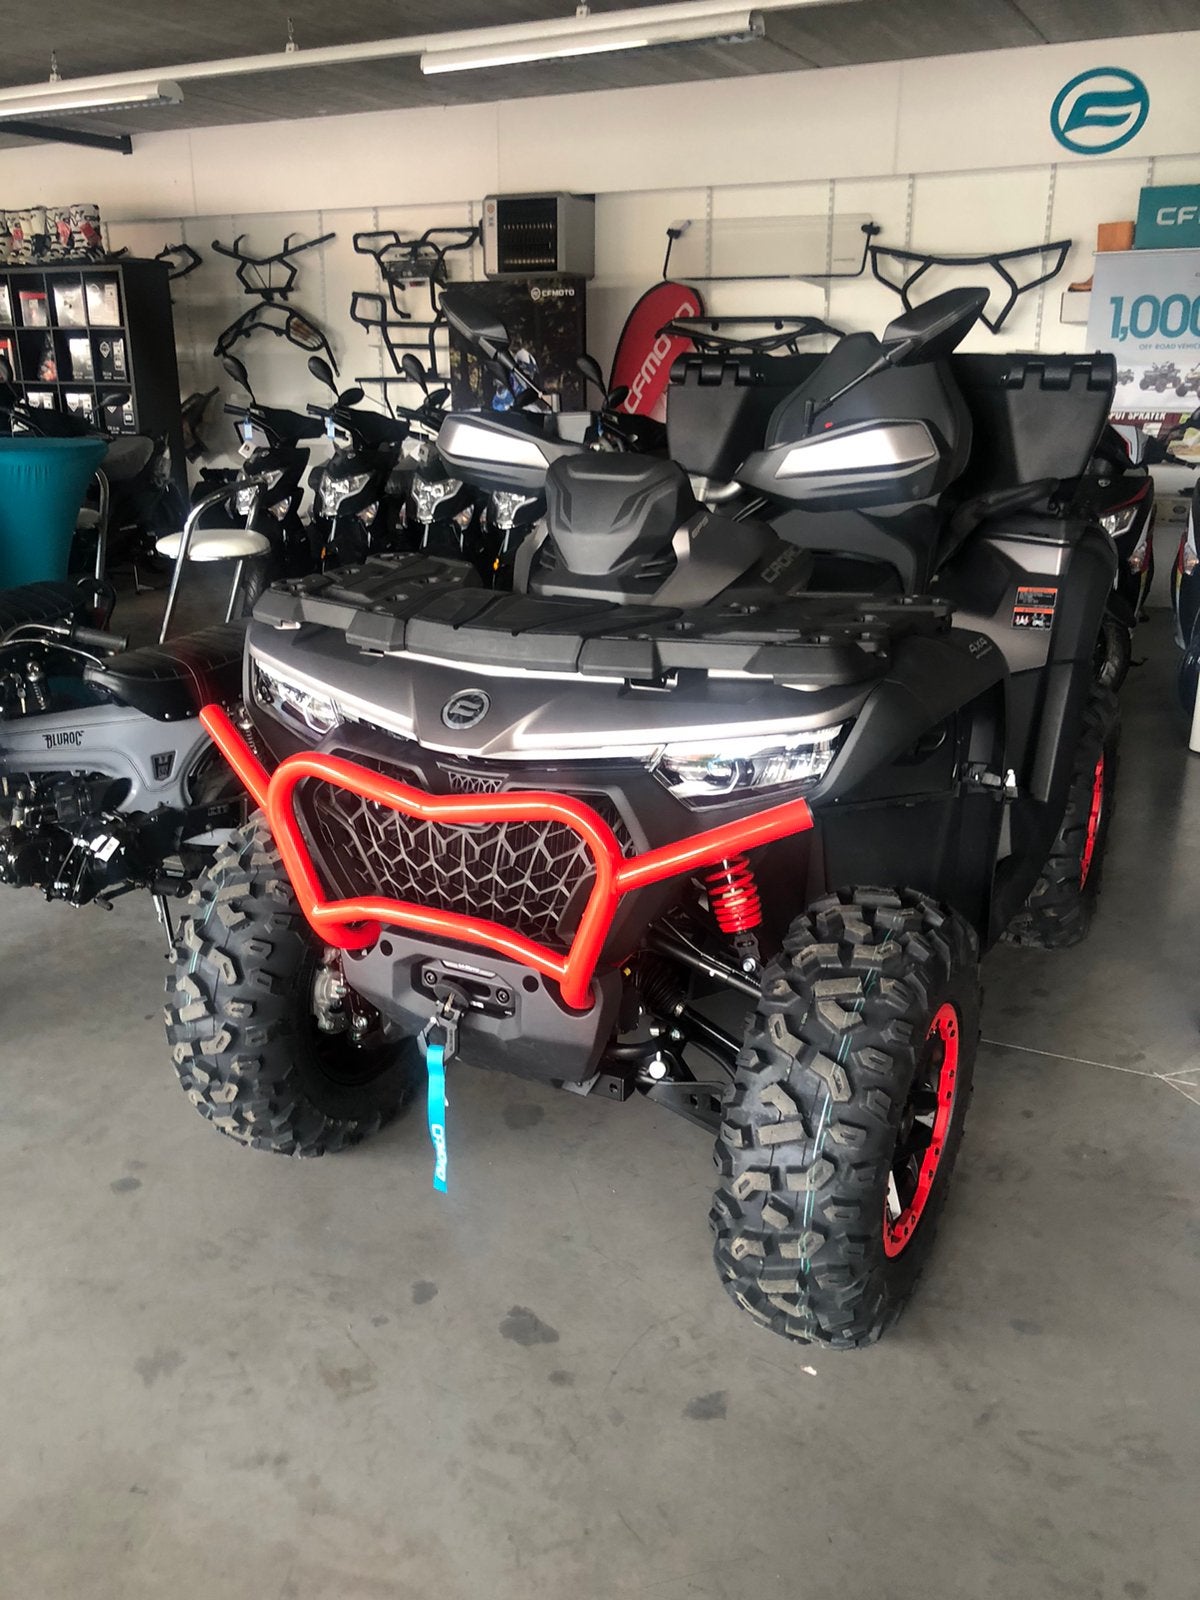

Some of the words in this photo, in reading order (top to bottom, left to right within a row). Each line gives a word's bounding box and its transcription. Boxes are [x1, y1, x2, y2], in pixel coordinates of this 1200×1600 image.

[1156, 206, 1200, 225] CF
[541, 289, 575, 297] CFMOTO
[1177, 342, 1200, 350] VEHIC
[624, 302, 695, 414] CFMOO
[42, 730, 85, 749] BLUROC
